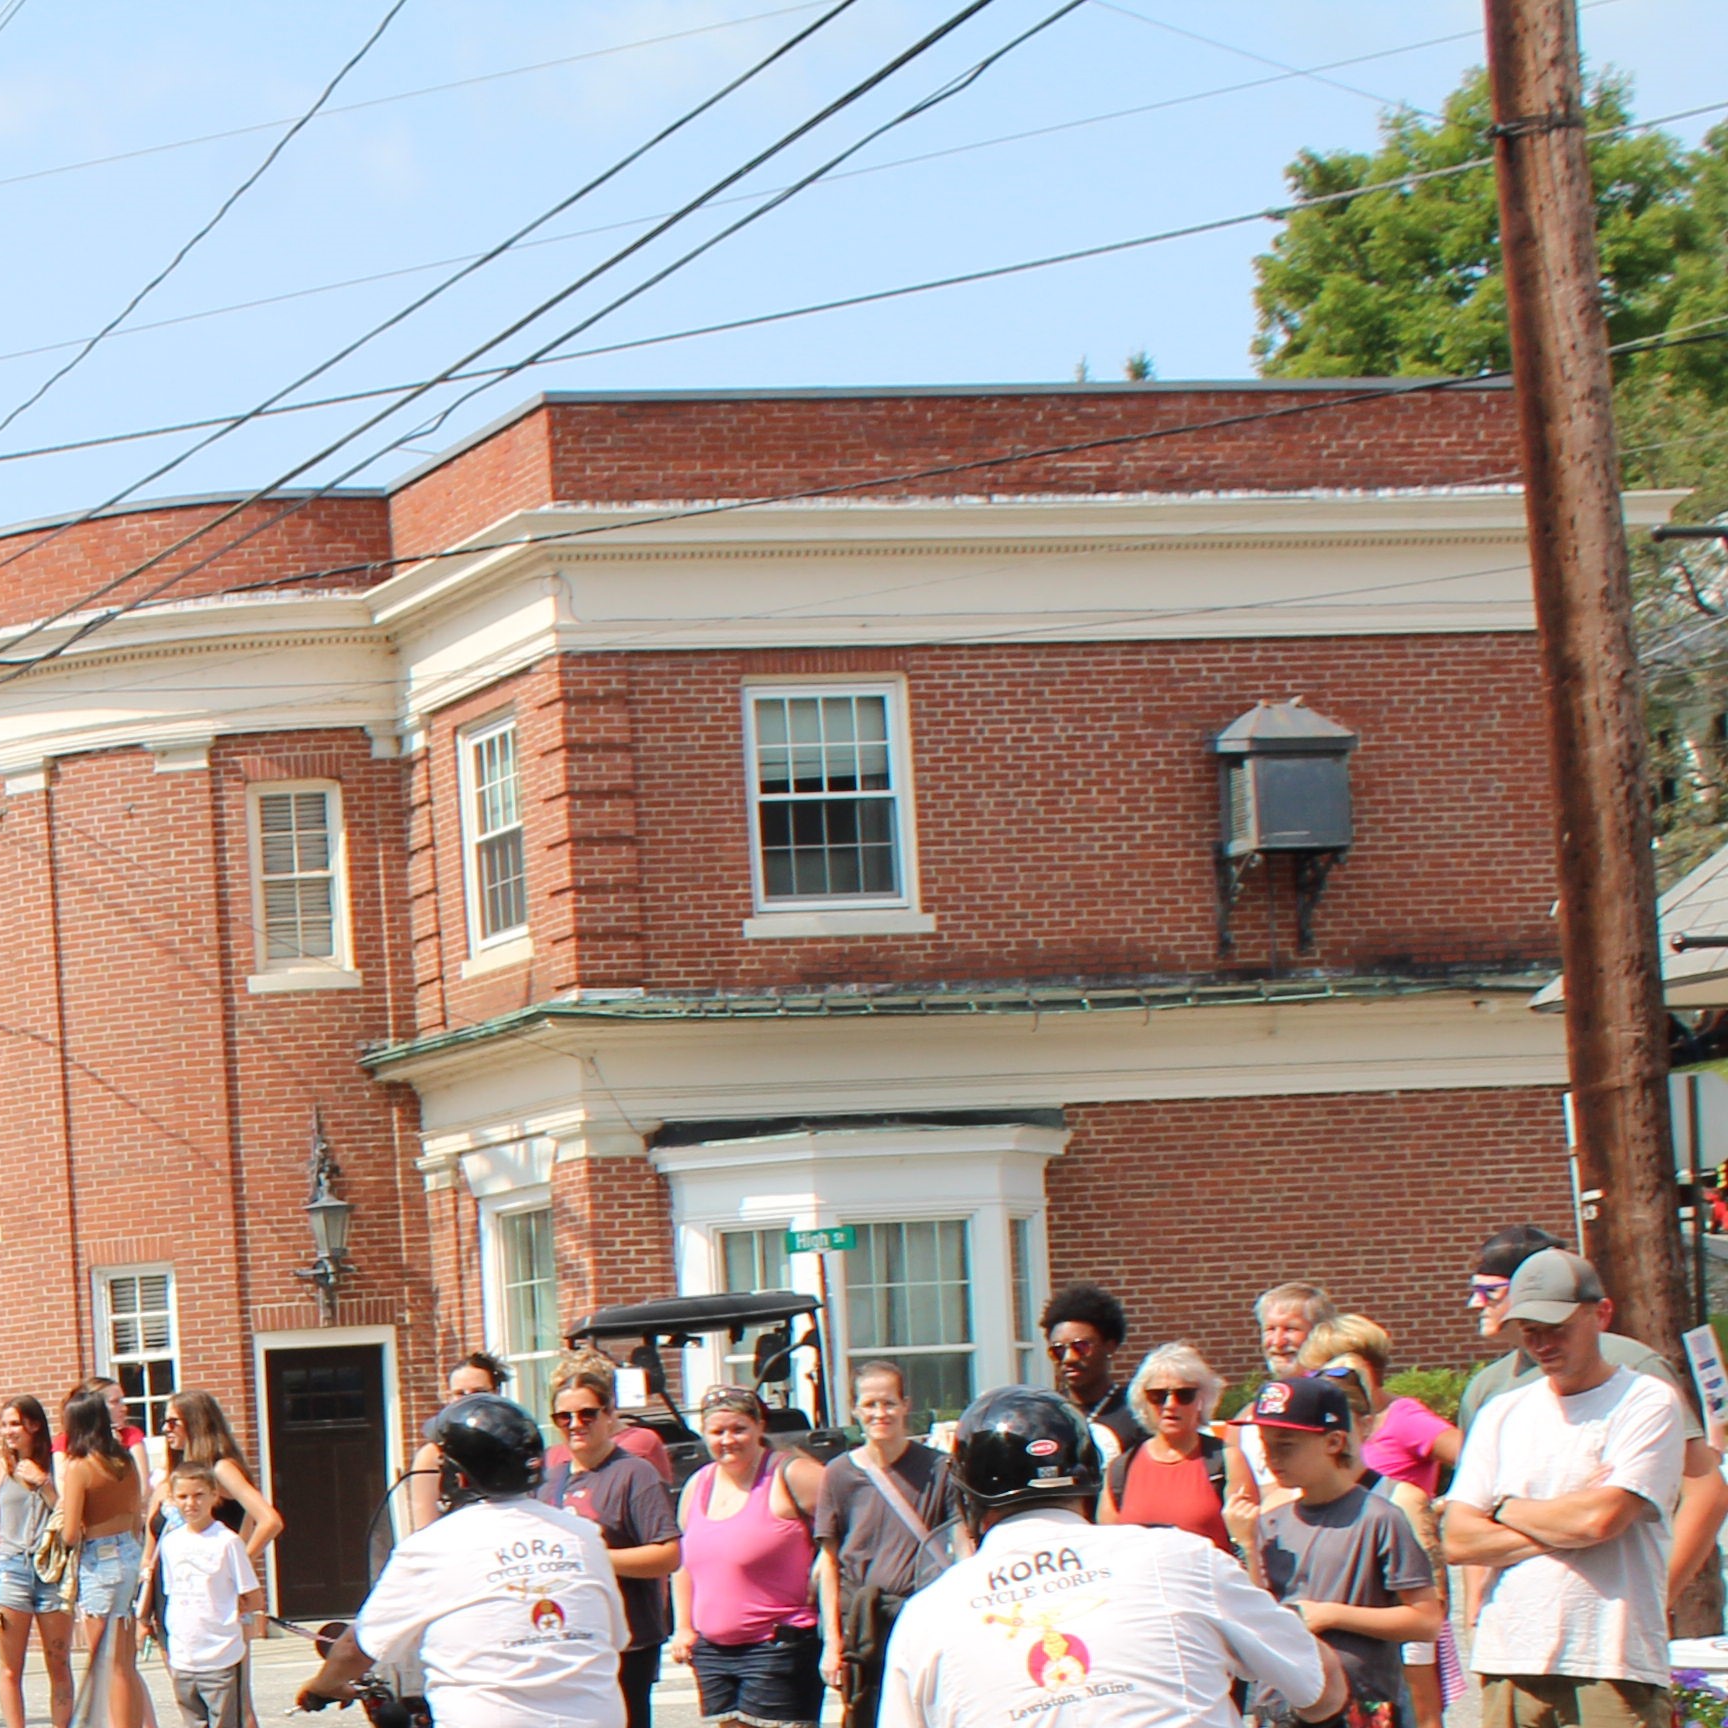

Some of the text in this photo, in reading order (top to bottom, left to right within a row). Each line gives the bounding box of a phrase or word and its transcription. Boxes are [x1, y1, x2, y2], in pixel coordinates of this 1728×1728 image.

[795, 1231, 829, 1250] High
[494, 1539, 565, 1566] KORA
[987, 1547, 1083, 1591] KORA
[485, 1563, 536, 1584] CYCLE
[969, 1566, 1113, 1609] CYCLE CORPS
[1008, 1681, 1136, 1722] Lewiston, Maine
